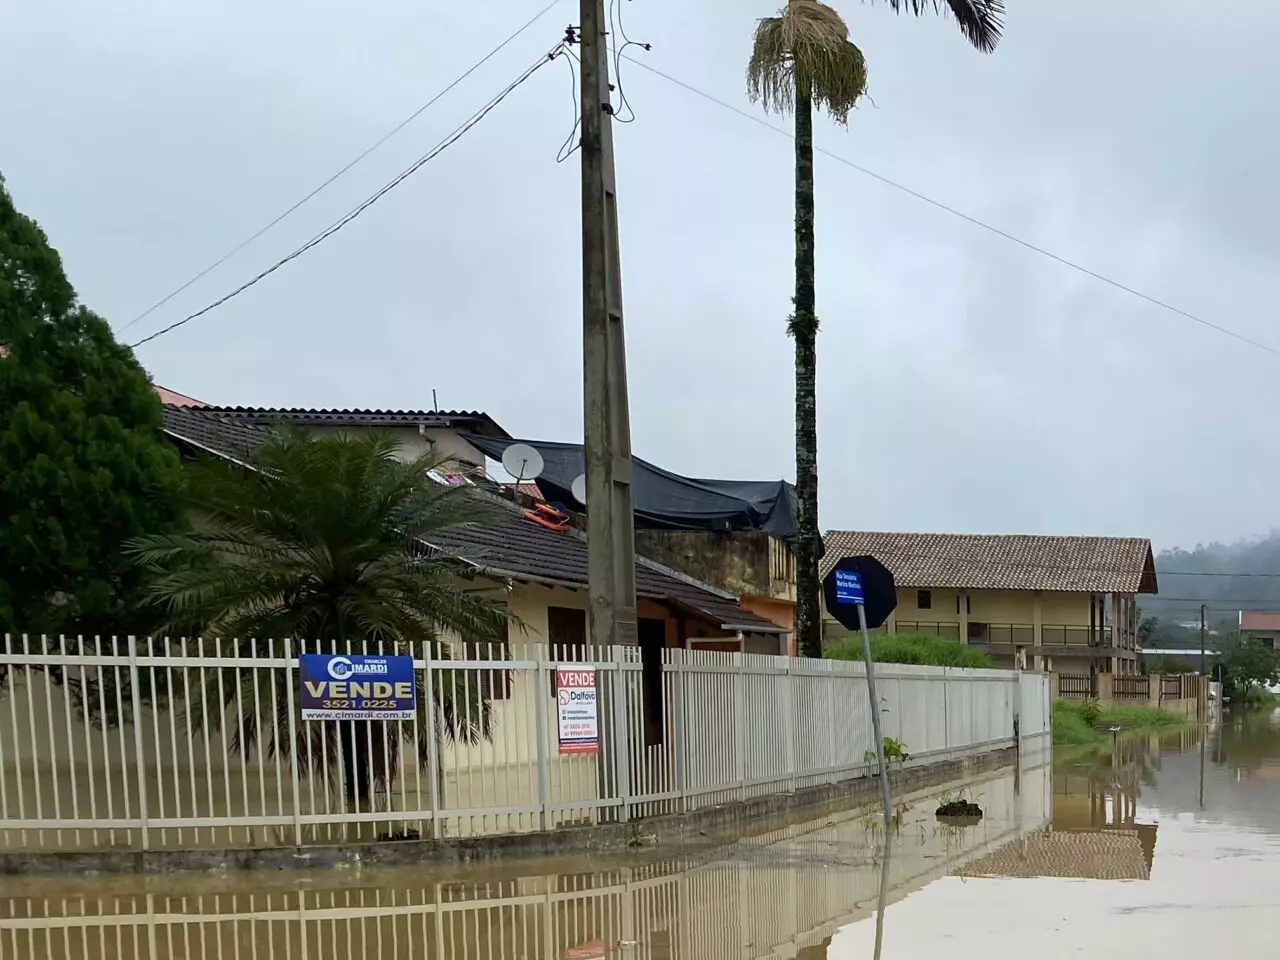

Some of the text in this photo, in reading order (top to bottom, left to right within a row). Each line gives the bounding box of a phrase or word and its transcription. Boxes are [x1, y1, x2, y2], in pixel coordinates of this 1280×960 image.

[327, 656, 388, 680] CIMARDI
[560, 672, 595, 686] VENDE
[304, 681, 413, 699] VENDE
[322, 700, 398, 709] 3521.0225
[306, 711, 412, 719] www.cimardi.com.br
